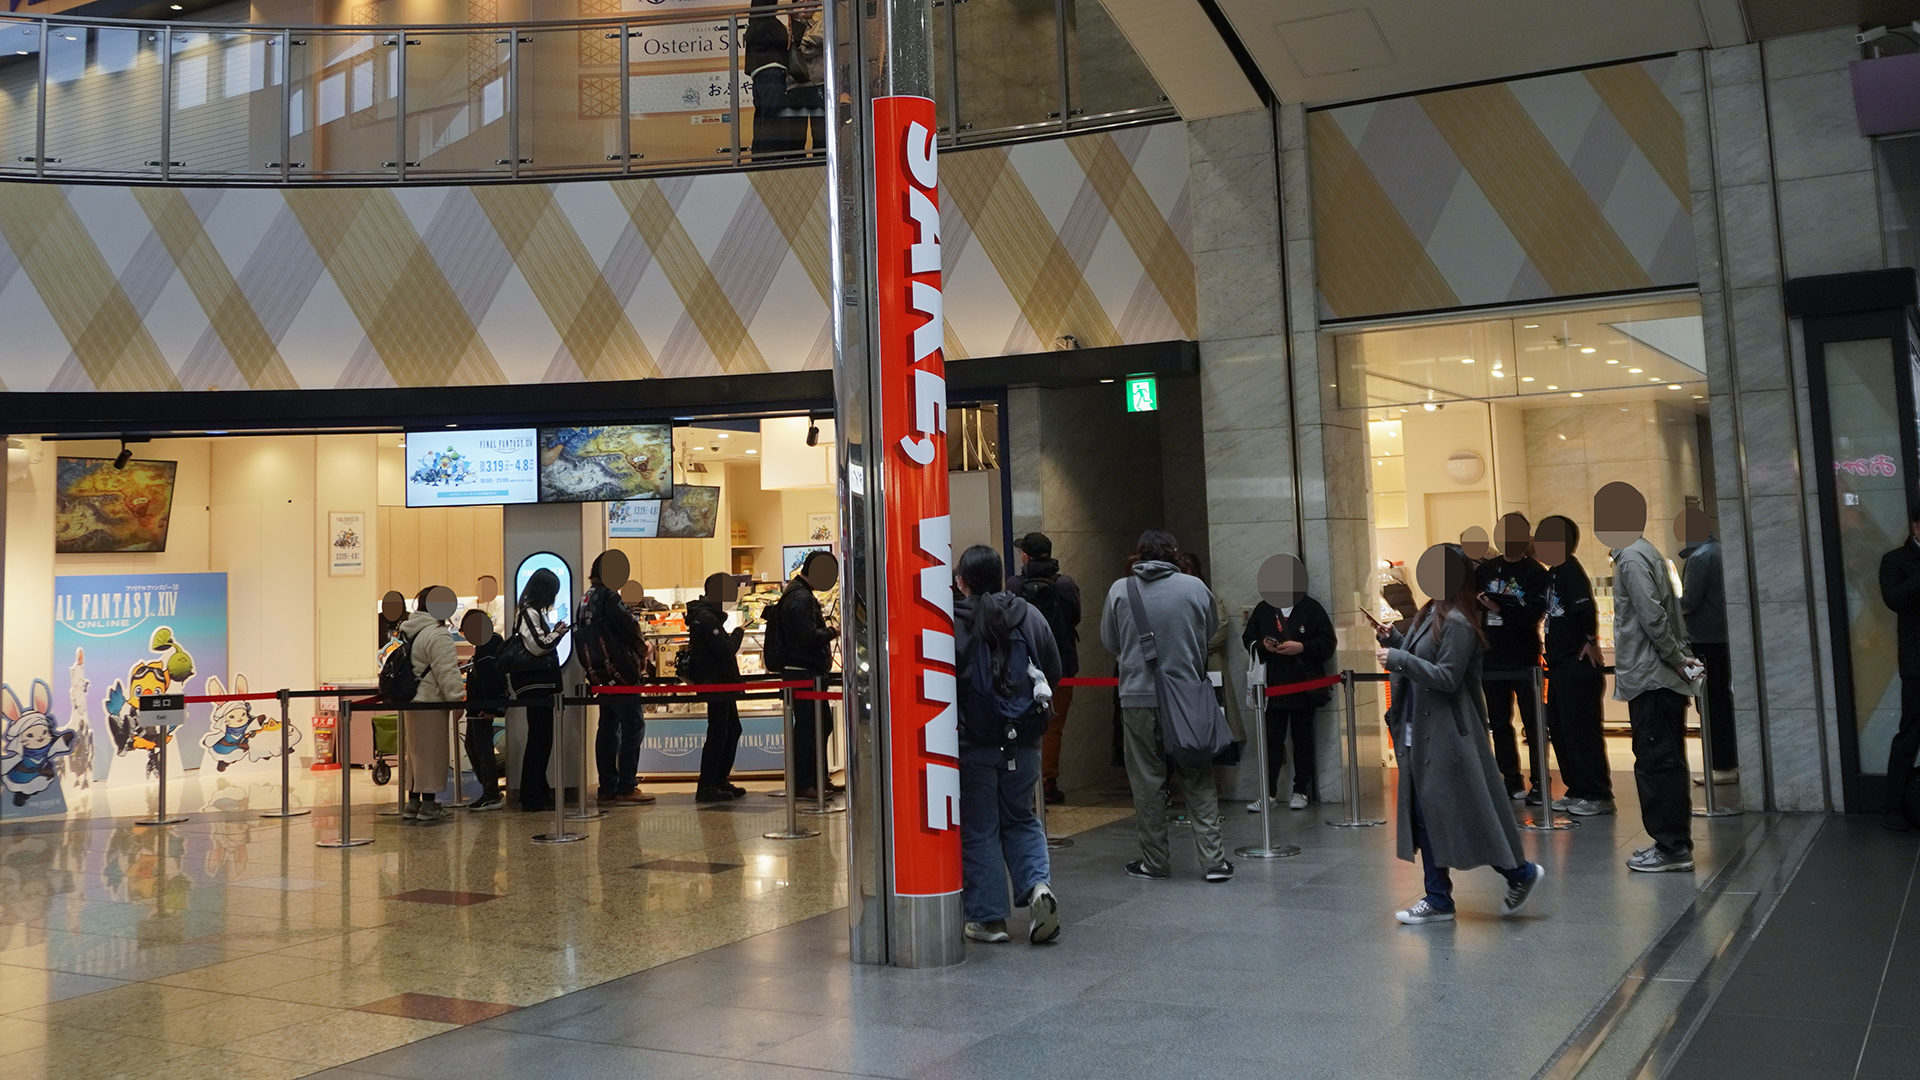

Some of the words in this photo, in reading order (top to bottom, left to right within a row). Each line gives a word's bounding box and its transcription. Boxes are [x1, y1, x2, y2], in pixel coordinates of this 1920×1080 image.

[644, 36, 713, 55] Osteria
[486, 460, 504, 472] 3.19
[515, 459, 529, 471] 4.8
[157, 591, 178, 617] XIV
[76, 619, 130, 629] ONLINE
[152, 698, 172, 708] 出口
[640, 737, 662, 749] INAL
[740, 735, 763, 748] FINAL
[766, 734, 785, 747] FANT
